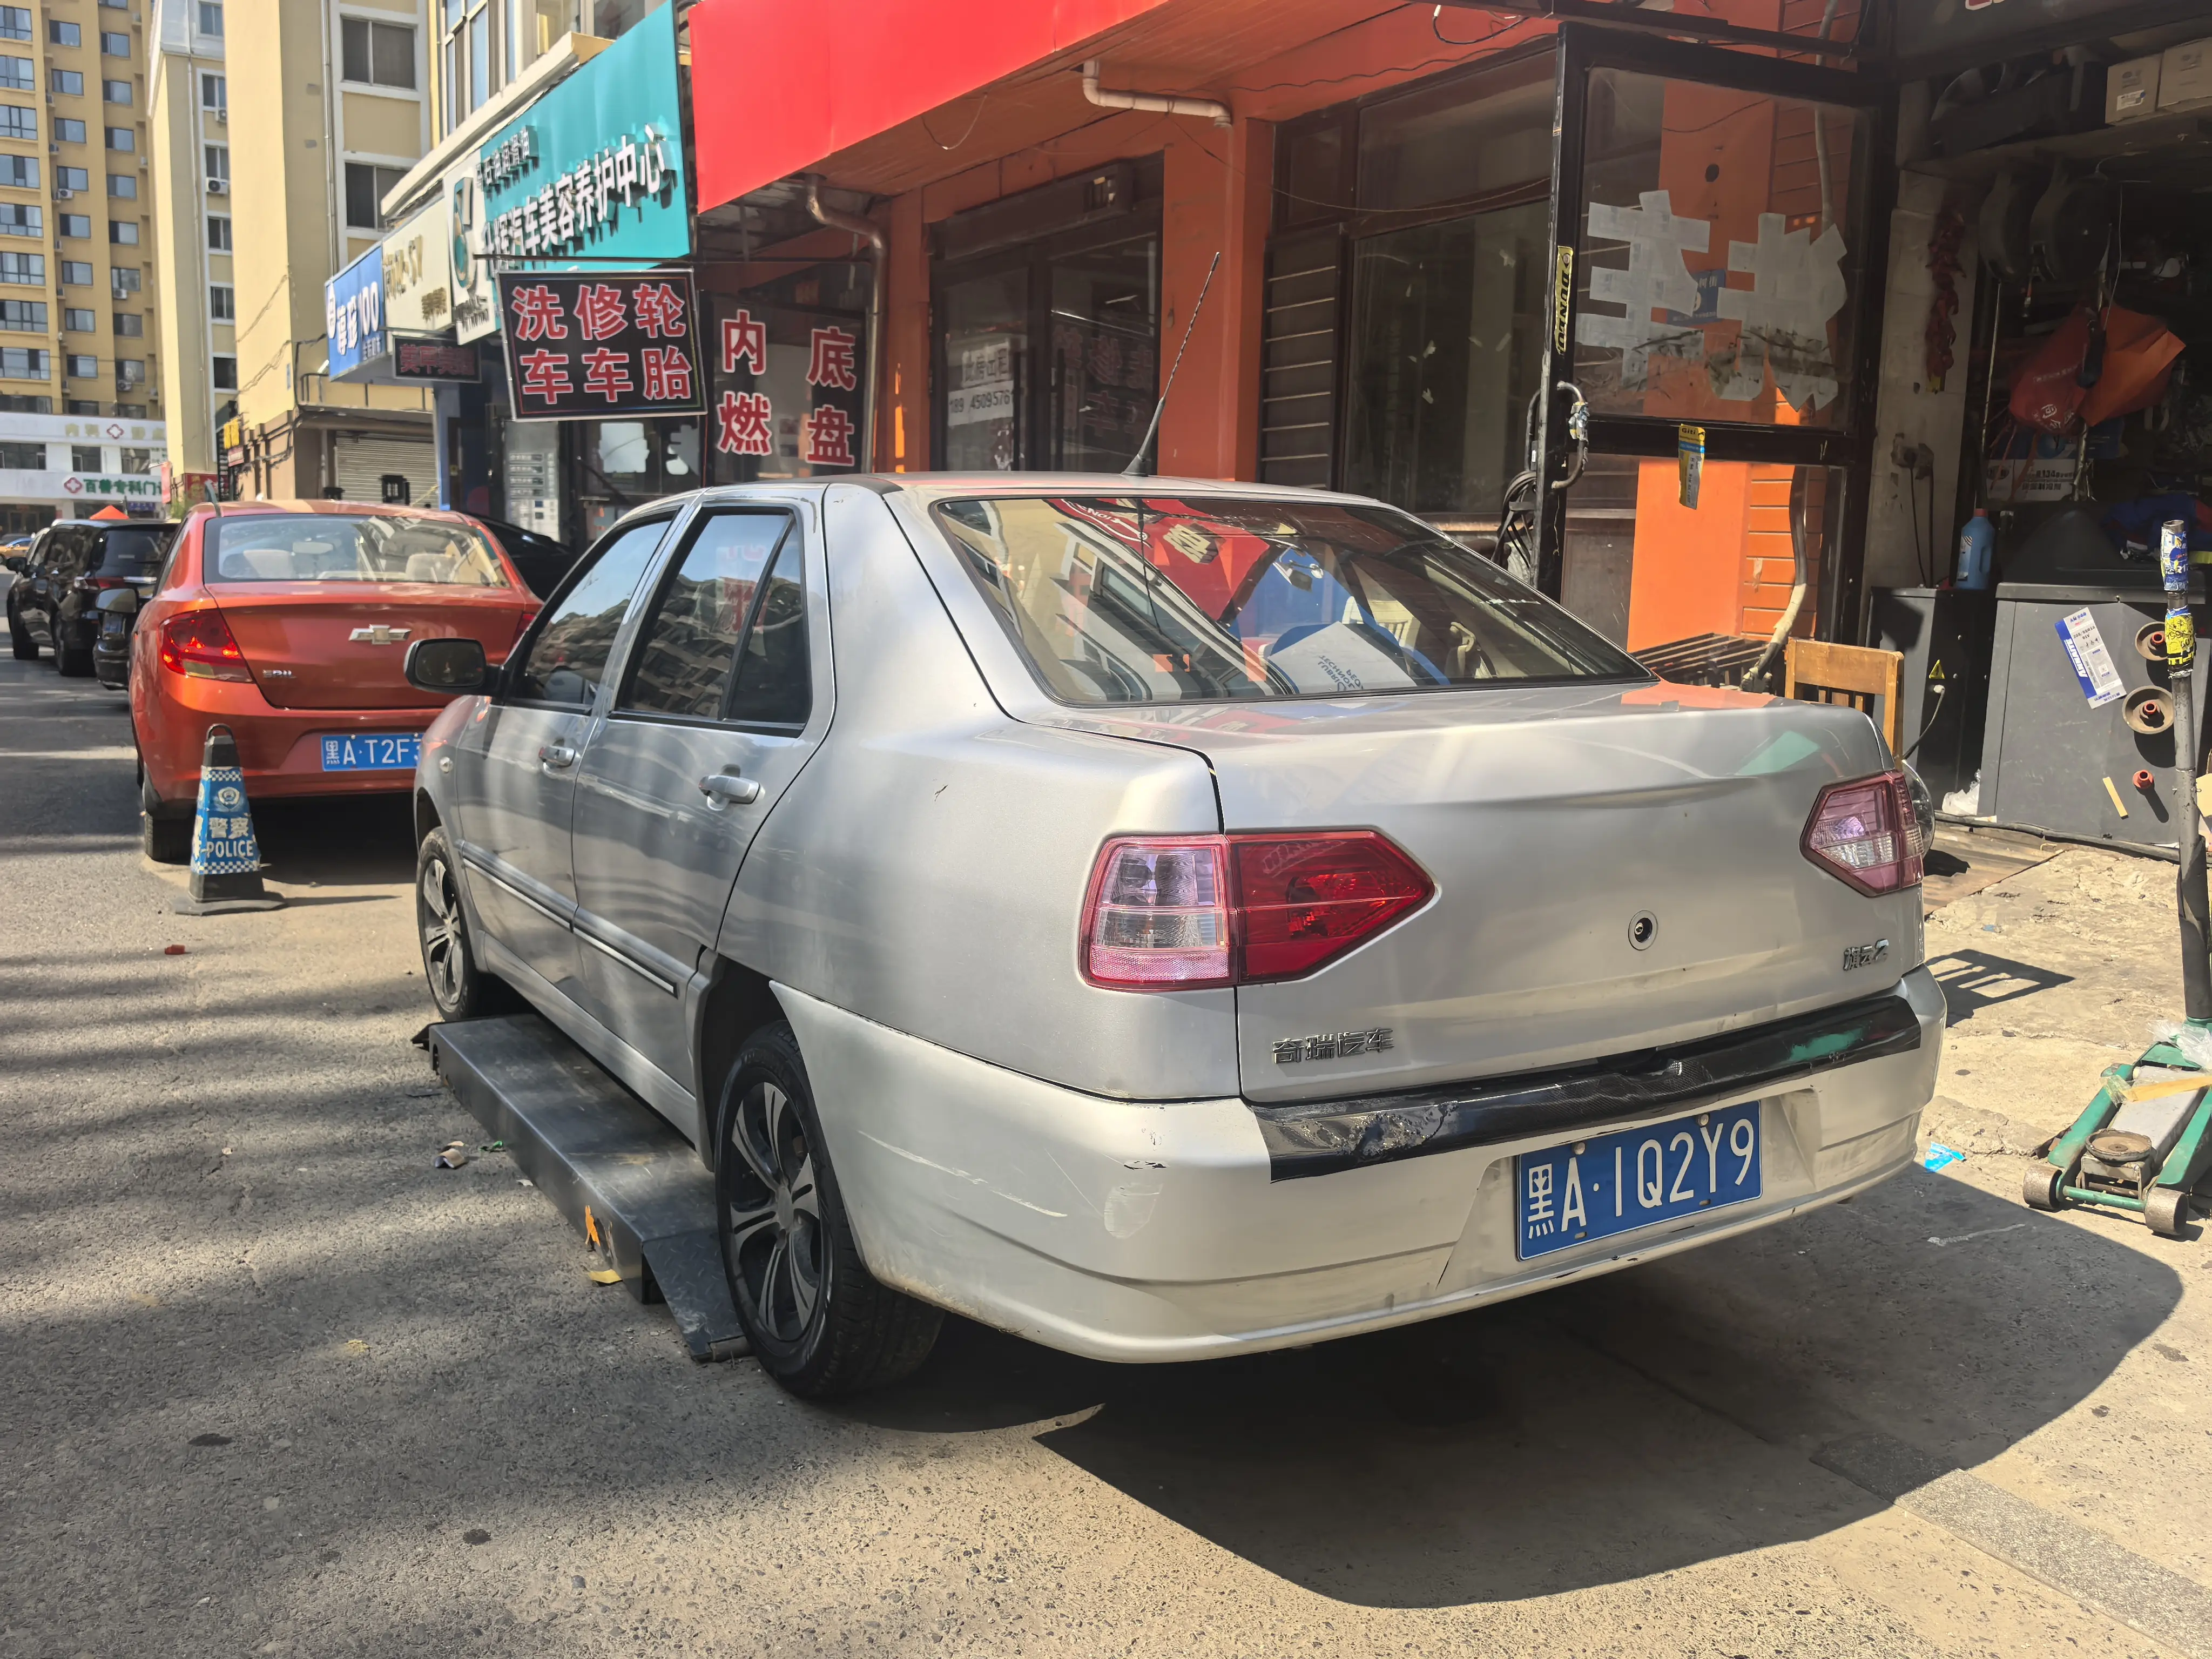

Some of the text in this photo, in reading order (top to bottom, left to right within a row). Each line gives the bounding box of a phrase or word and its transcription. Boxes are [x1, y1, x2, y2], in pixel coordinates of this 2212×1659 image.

[511, 285, 573, 404] 洗车
[575, 284, 633, 402] 修车
[633, 284, 692, 400] 轮胎
[1557, 270, 1569, 354] DUNLO
[717, 309, 772, 456] 内燃
[806, 326, 857, 466] 底盘
[2063, 638, 2088, 678] ANNAITE
[206, 840, 253, 858] POLICE
[209, 817, 248, 839] 警察
[1272, 1027, 1394, 1064] 奇瑞汽车
